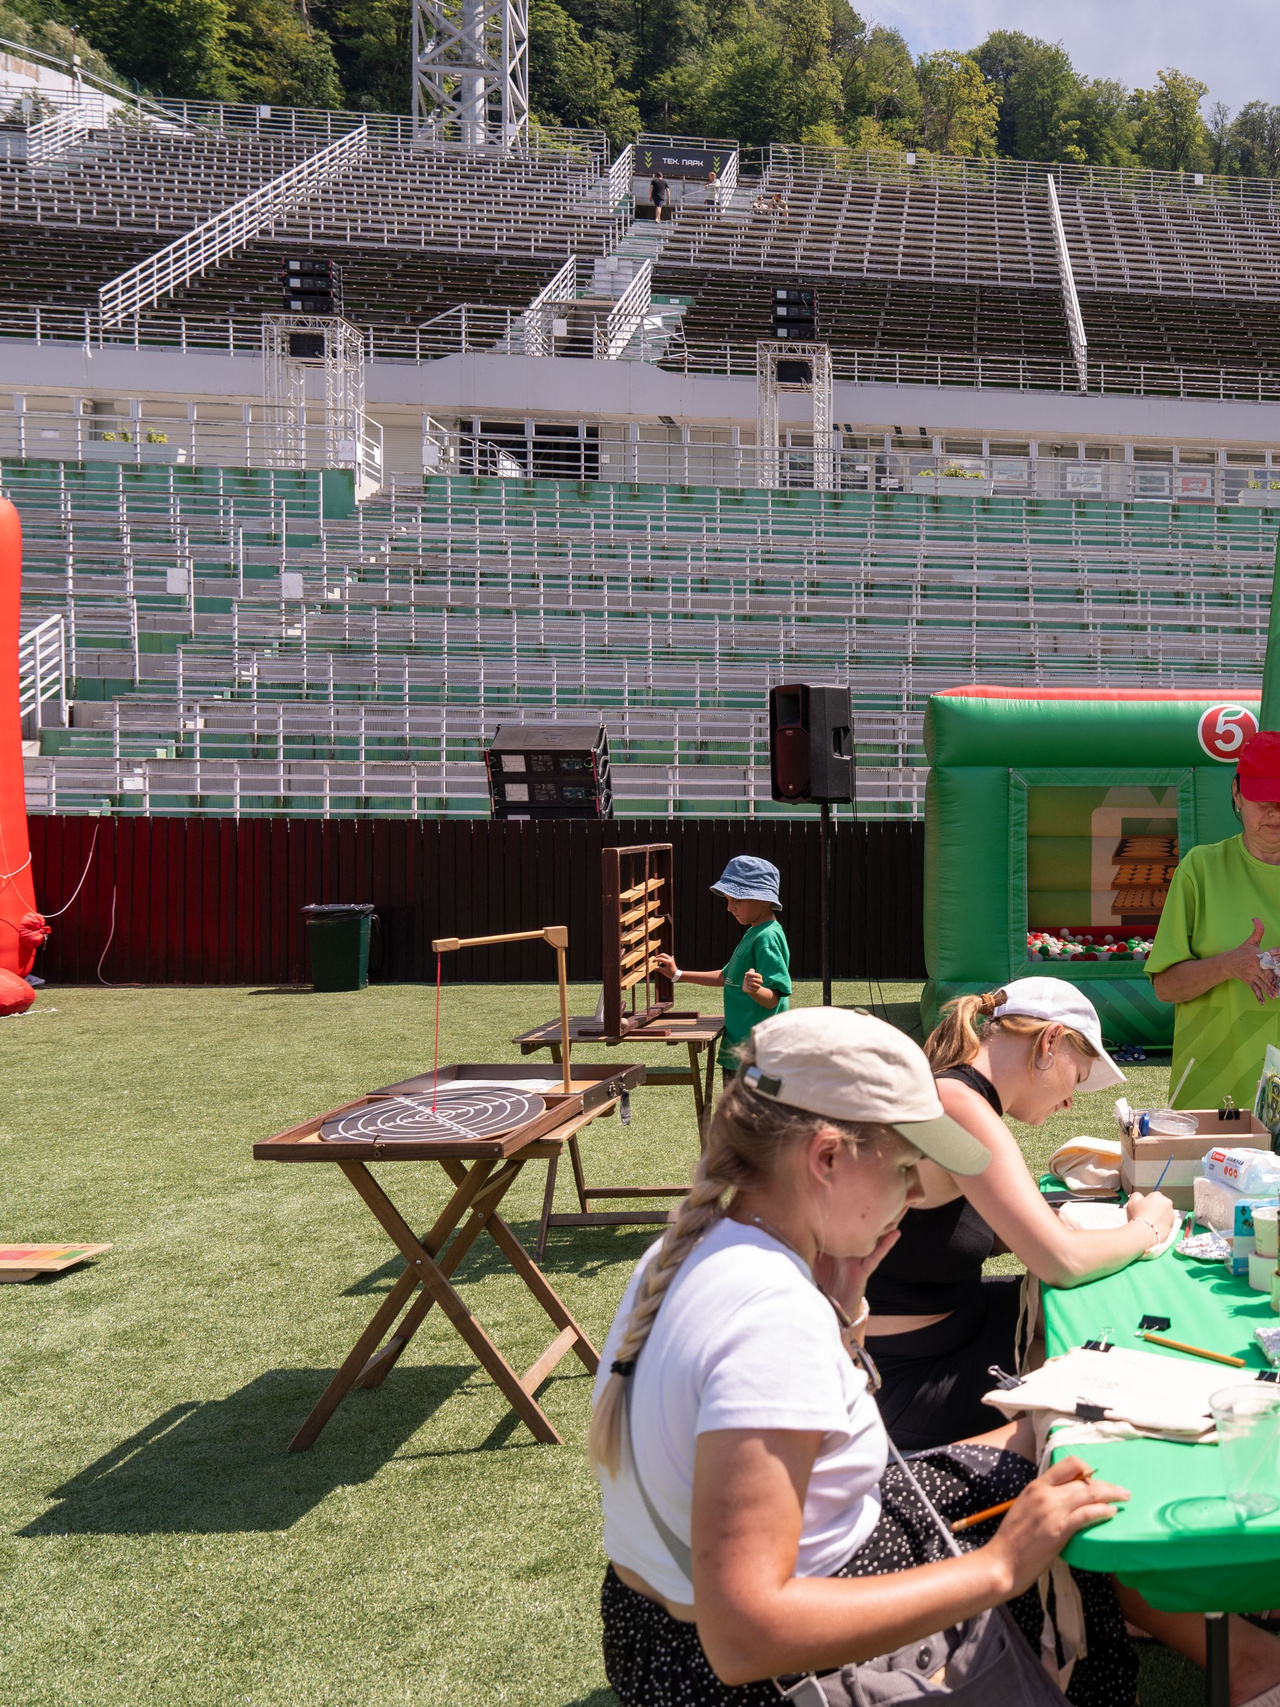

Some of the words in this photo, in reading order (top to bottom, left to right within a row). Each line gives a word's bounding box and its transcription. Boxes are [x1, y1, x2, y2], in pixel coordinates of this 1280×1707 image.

[662, 157, 679, 165] ТЕХ.
[682, 159, 704, 167] ПАРК
[1214, 708, 1246, 752] 5
